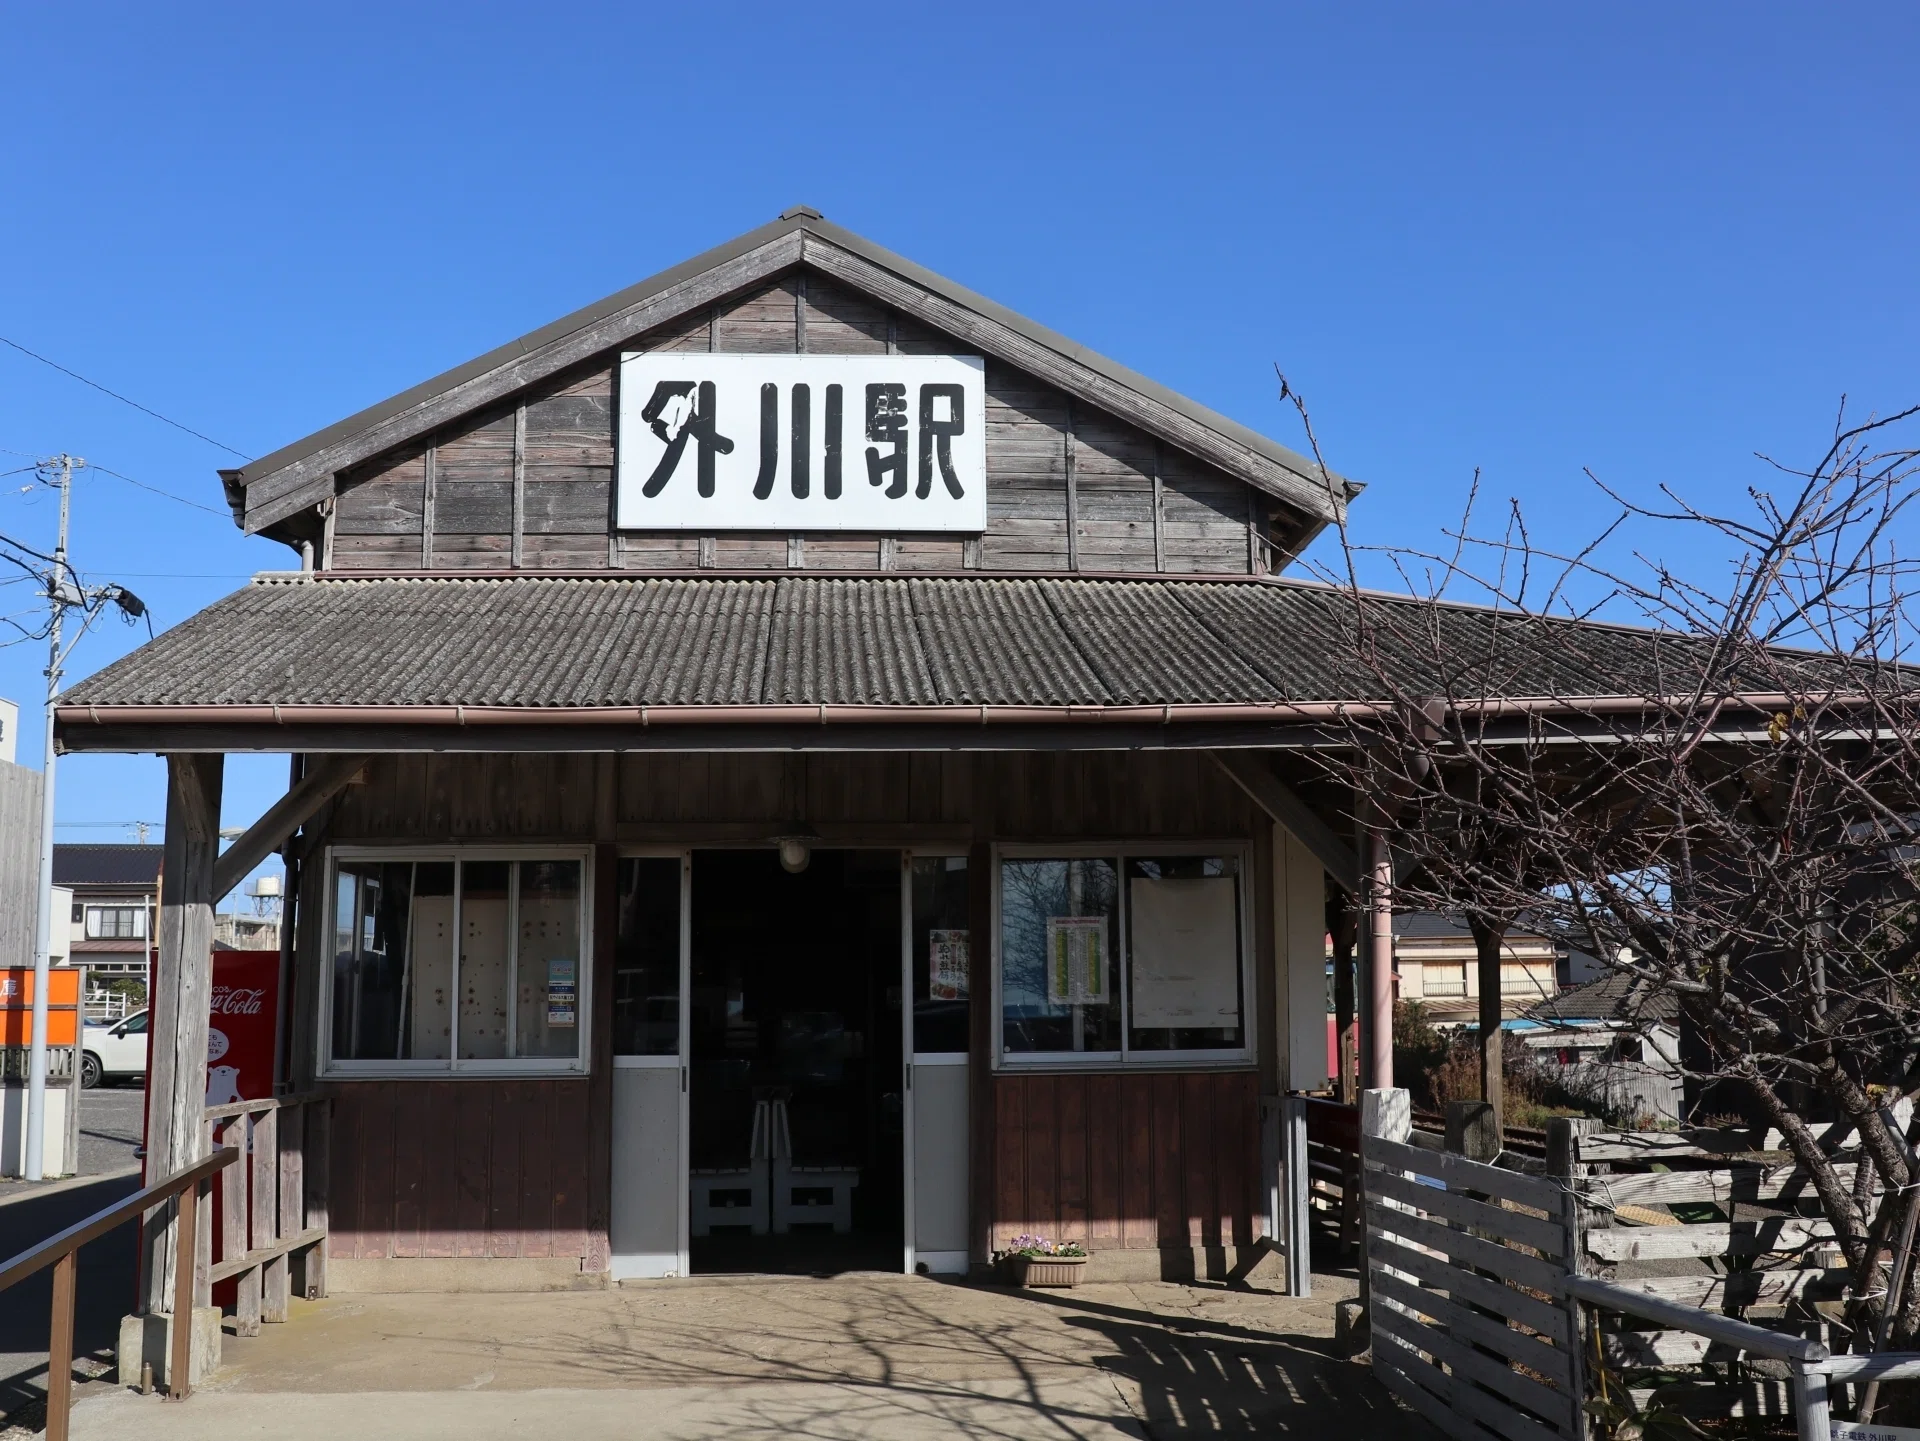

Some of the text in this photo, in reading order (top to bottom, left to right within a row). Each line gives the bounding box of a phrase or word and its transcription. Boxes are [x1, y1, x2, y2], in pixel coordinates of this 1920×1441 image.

[641, 380, 965, 500] 外川駅
[0, 979, 18, 998] 庫
[210, 989, 266, 1014] a-Cola
